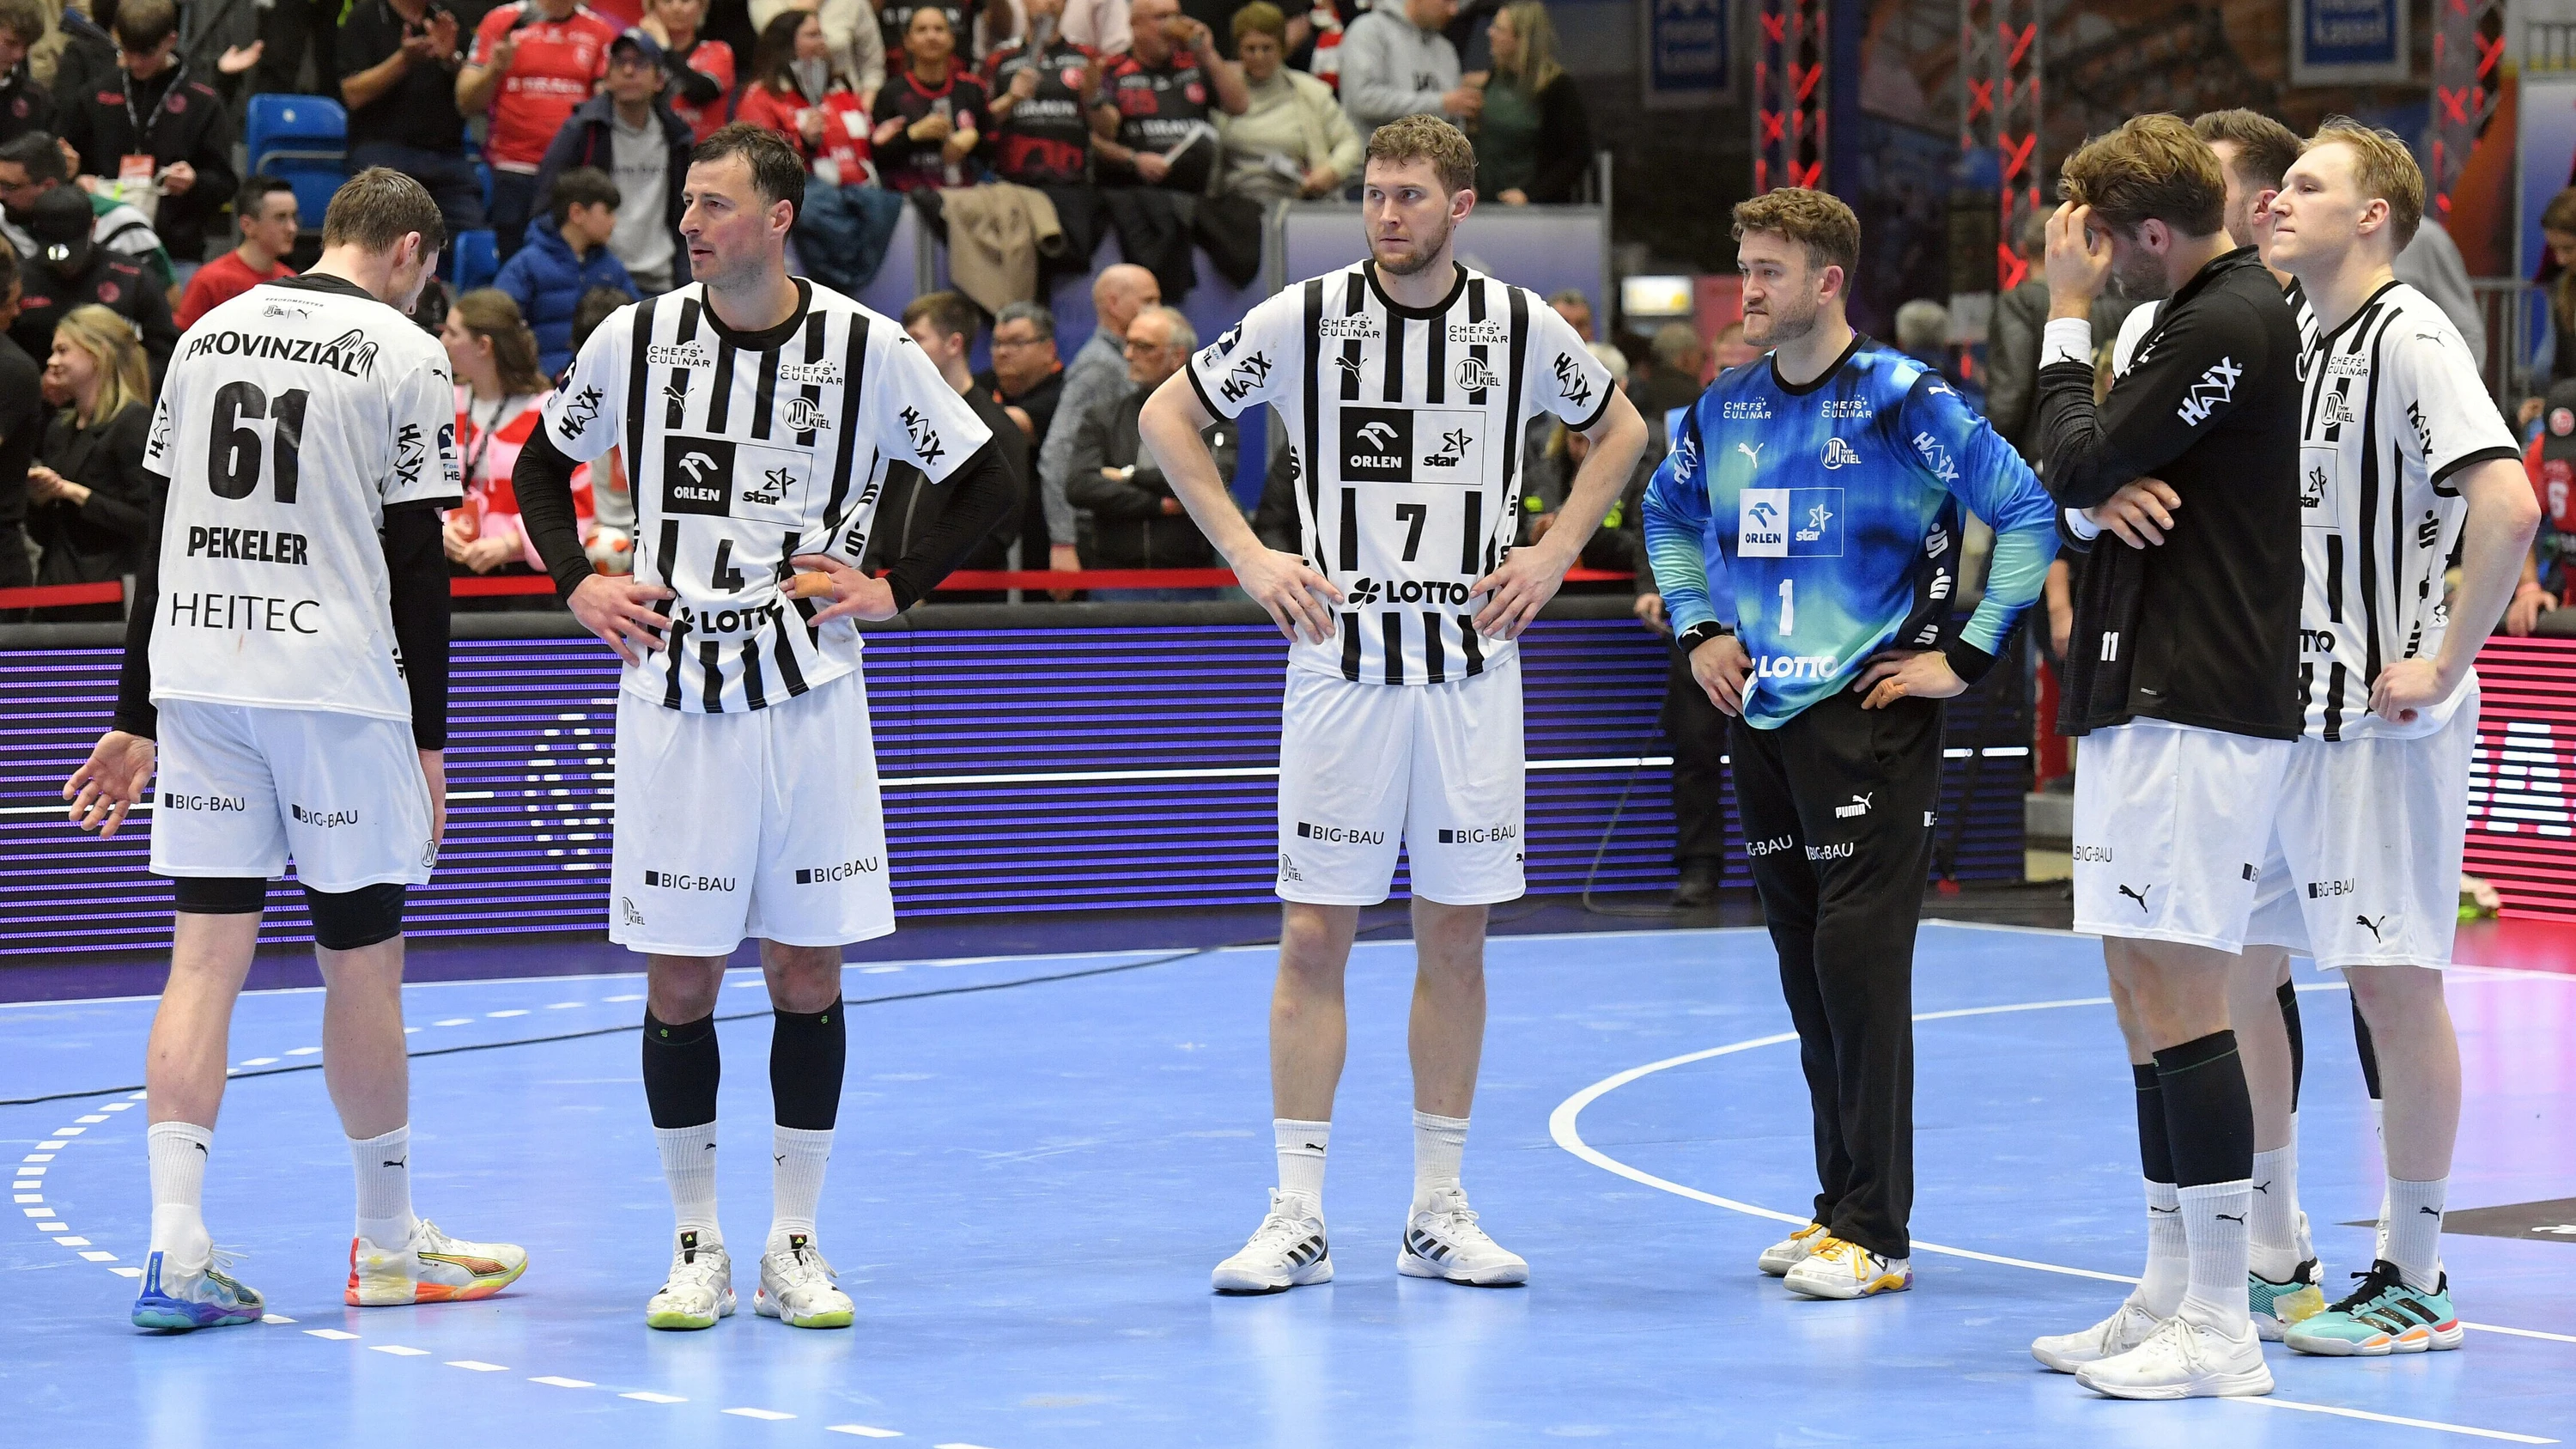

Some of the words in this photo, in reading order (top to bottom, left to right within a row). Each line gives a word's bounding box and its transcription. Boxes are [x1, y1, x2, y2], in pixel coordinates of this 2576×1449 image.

[1321, 320, 1367, 330] CHEFS
[1449, 325, 1495, 335] CHEFS
[1321, 328, 1381, 339] CULINAR
[1449, 333, 1509, 344] CULINAR
[185, 331, 358, 377] PROVINZIAL
[649, 344, 698, 357] CHEFS
[648, 355, 711, 368] CULINAR
[2330, 356, 2362, 367] CHEFS
[781, 364, 830, 375] CHEFS
[2327, 366, 2369, 377] CULINAR
[780, 373, 843, 387] CULINAR
[1479, 376, 1501, 387] KIEL
[1724, 401, 1762, 411] CHEFS
[1822, 400, 1863, 410] CHEFS
[1722, 410, 1771, 419] CULINAR
[1821, 408, 1873, 419] CULINAR
[2336, 411, 2355, 423] KIEL
[809, 417, 831, 429] KIEL
[208, 381, 309, 504] 61
[1351, 454, 1402, 469] ORLEN
[1423, 454, 1459, 468] star
[1841, 454, 1862, 465] KIEL
[444, 471, 460, 481] HB
[673, 486, 720, 502] ORLEN
[742, 490, 780, 506] star
[1395, 503, 1426, 562] 7
[1745, 533, 1782, 545] ORLEN
[1795, 528, 1820, 542] star
[186, 526, 308, 566] PEKELER
[711, 539, 744, 594] 4
[1387, 581, 1470, 606] LOTTO
[170, 593, 320, 635] HEITEC
[1778, 578, 1794, 636] 1
[2100, 630, 2119, 661] 11
[2300, 630, 2336, 653] TTO
[1758, 655, 1838, 679] LOTTO
[175, 795, 246, 813] BIG-BAU
[1835, 804, 1866, 819] PUMA
[301, 809, 359, 828] BIG-BAU
[1313, 825, 1385, 845] BIG-BAU
[1456, 824, 1516, 844] BIG-BAU
[1745, 834, 1794, 856] IG-BAU
[1809, 842, 1855, 860] BIG-BAU
[2076, 845, 2112, 863] BIG-BAU
[815, 856, 878, 883] BIG-BAU
[1288, 871, 1303, 882] KIEL
[661, 874, 737, 892] BIG-BAU
[2318, 878, 2355, 898] BG-BAU
[629, 914, 646, 926] KIEL
